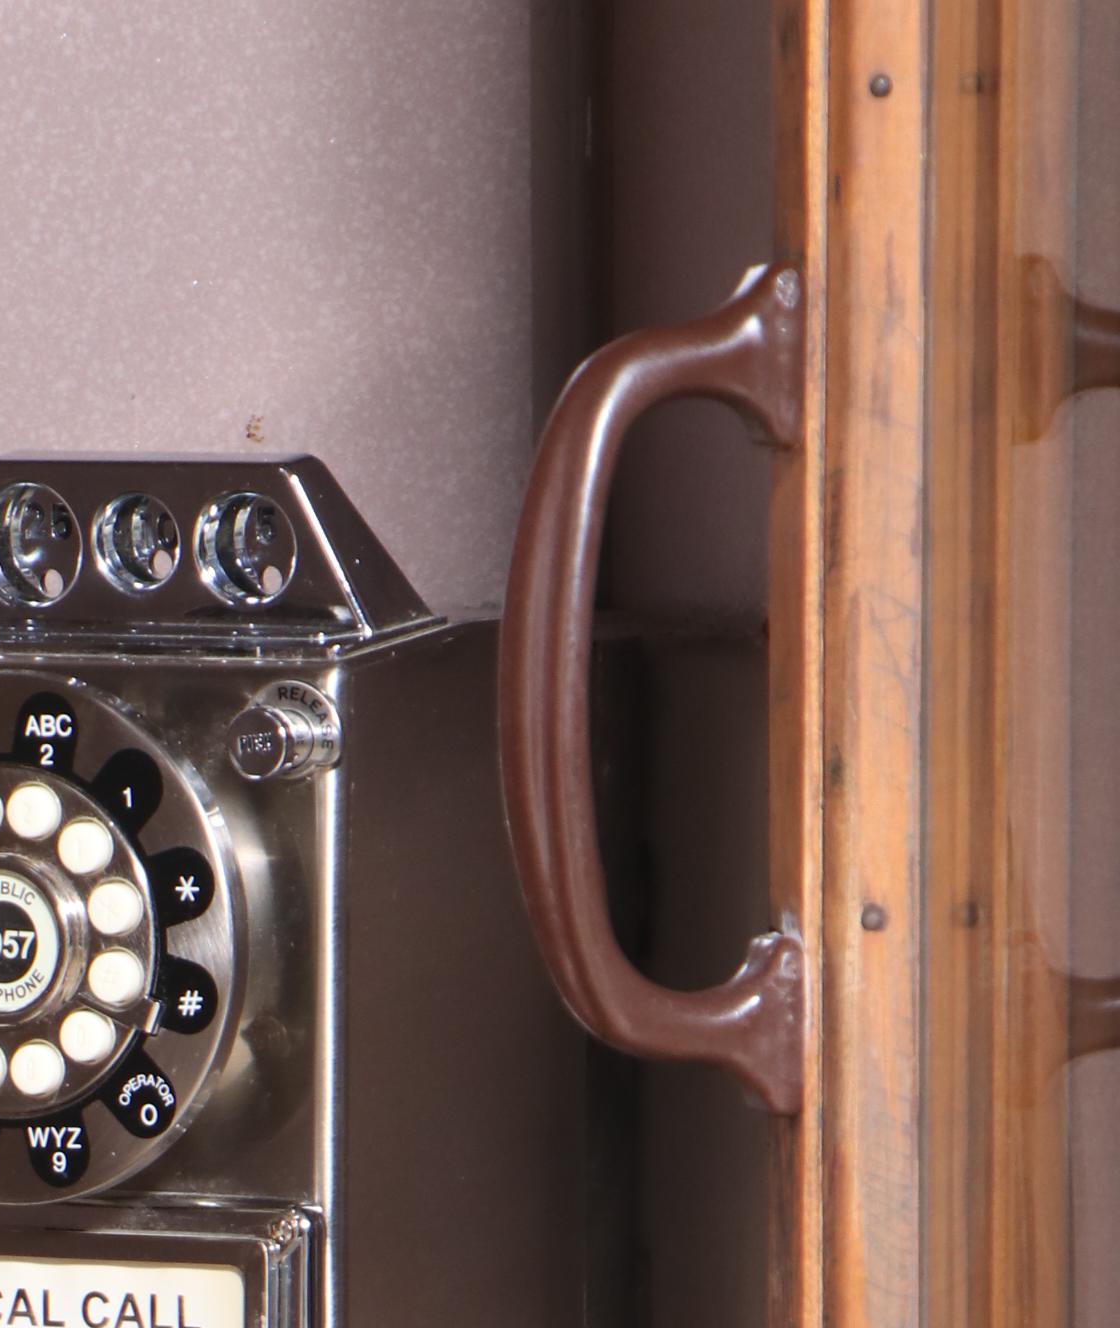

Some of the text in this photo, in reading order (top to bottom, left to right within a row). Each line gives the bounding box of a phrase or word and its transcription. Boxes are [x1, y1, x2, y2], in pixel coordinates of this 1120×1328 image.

[25, 502, 73, 541] 25
[25, 715, 72, 737] ABC
[277, 686, 334, 750] RELEASE
[41, 744, 53, 765] 2
[123, 788, 131, 807] 1
[178, 991, 203, 1015] #
[119, 1073, 175, 1107] OPERATOR
[141, 1104, 157, 1125] 0
[28, 1127, 81, 1148] WYZ
[53, 1152, 66, 1172] 9
